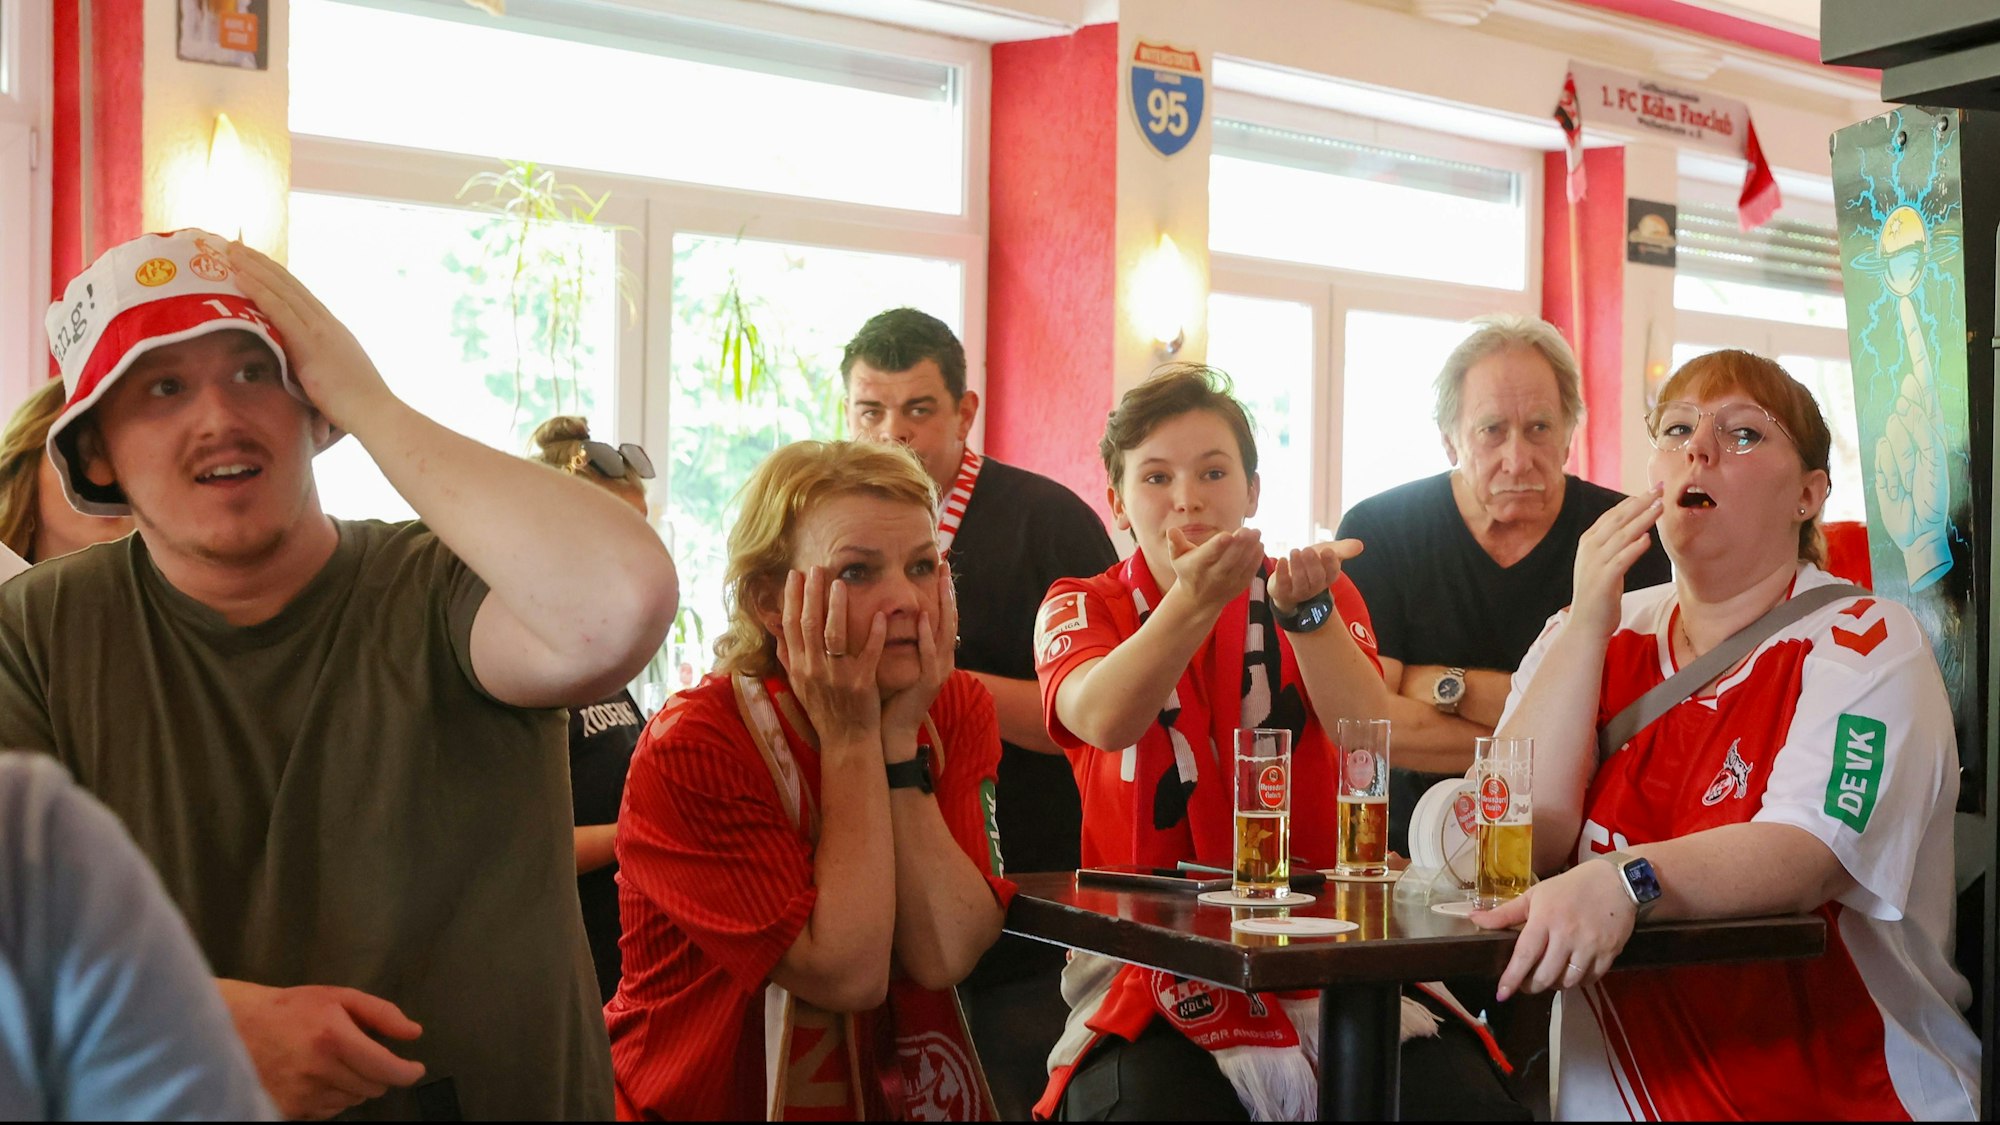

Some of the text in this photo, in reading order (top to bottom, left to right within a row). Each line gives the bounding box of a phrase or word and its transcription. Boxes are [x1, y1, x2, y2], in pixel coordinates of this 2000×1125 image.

[1147, 88, 1189, 137] 95
[1601, 85, 1613, 108] 1.
[1618, 89, 1638, 113] FC
[1641, 95, 1676, 122] Köln
[1680, 104, 1733, 136] Fanclub
[1837, 727, 1877, 819] DEVK
